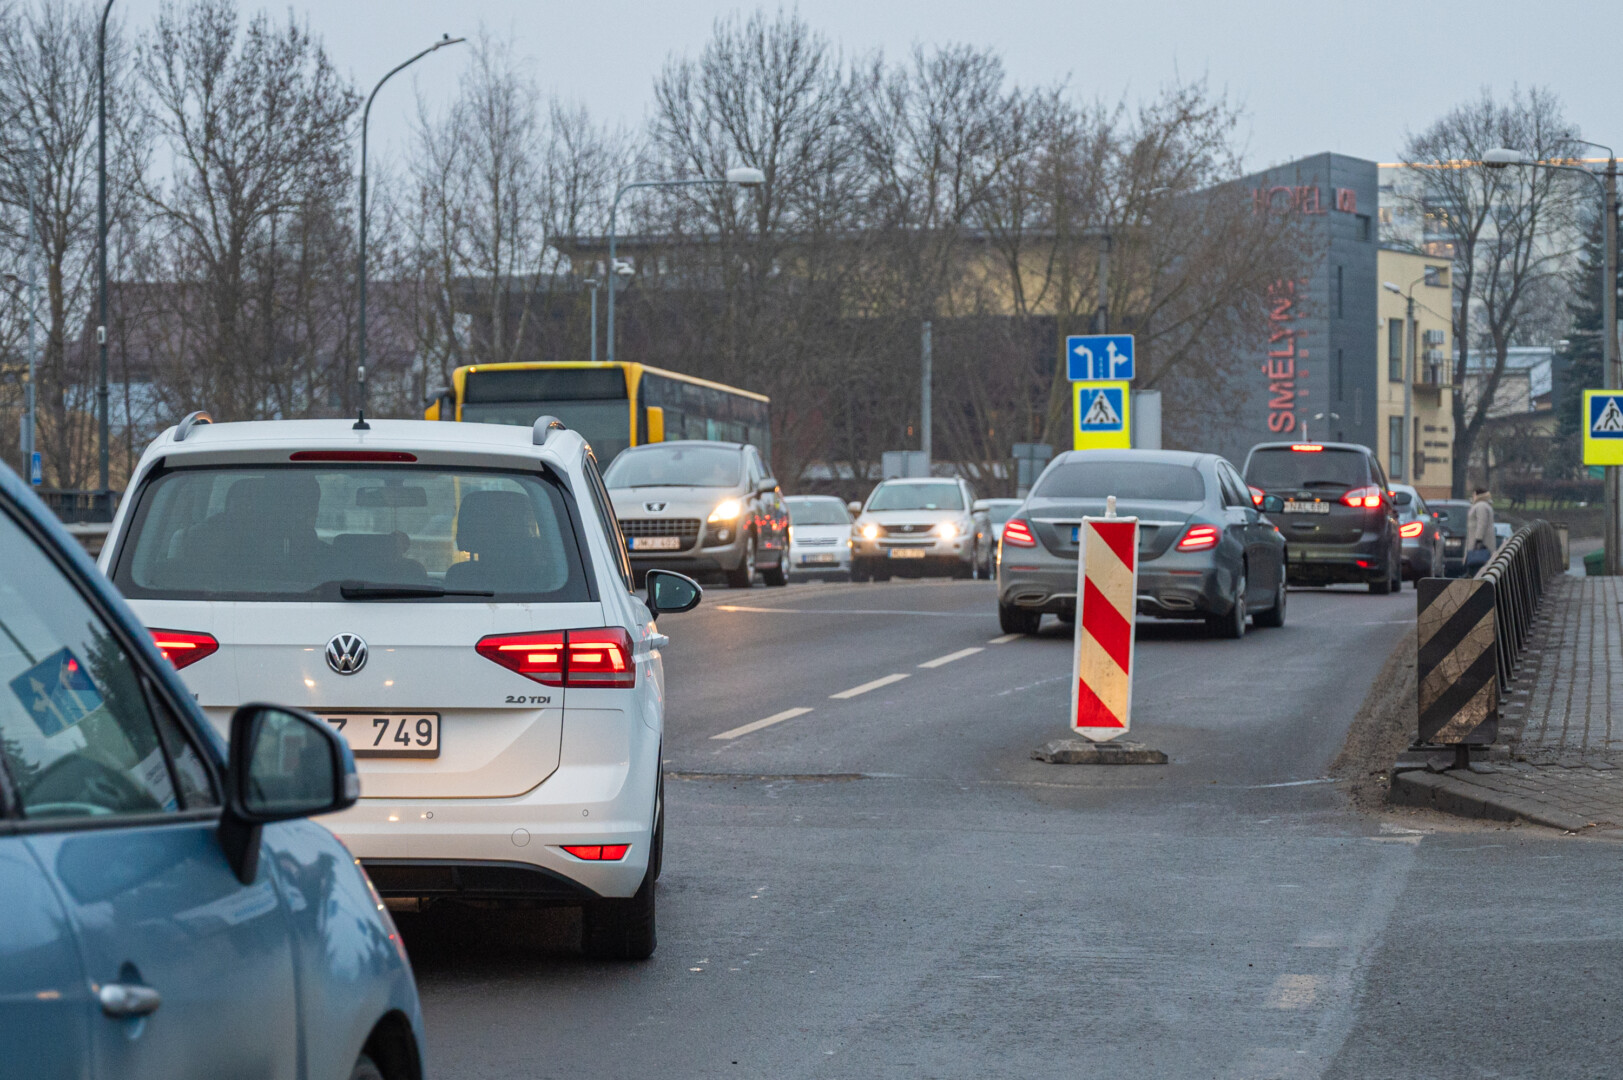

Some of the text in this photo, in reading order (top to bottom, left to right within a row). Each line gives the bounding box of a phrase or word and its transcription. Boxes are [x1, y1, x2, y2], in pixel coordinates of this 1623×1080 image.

[505, 695, 551, 704] 2.0 TDI
[373, 718, 432, 746] 749
